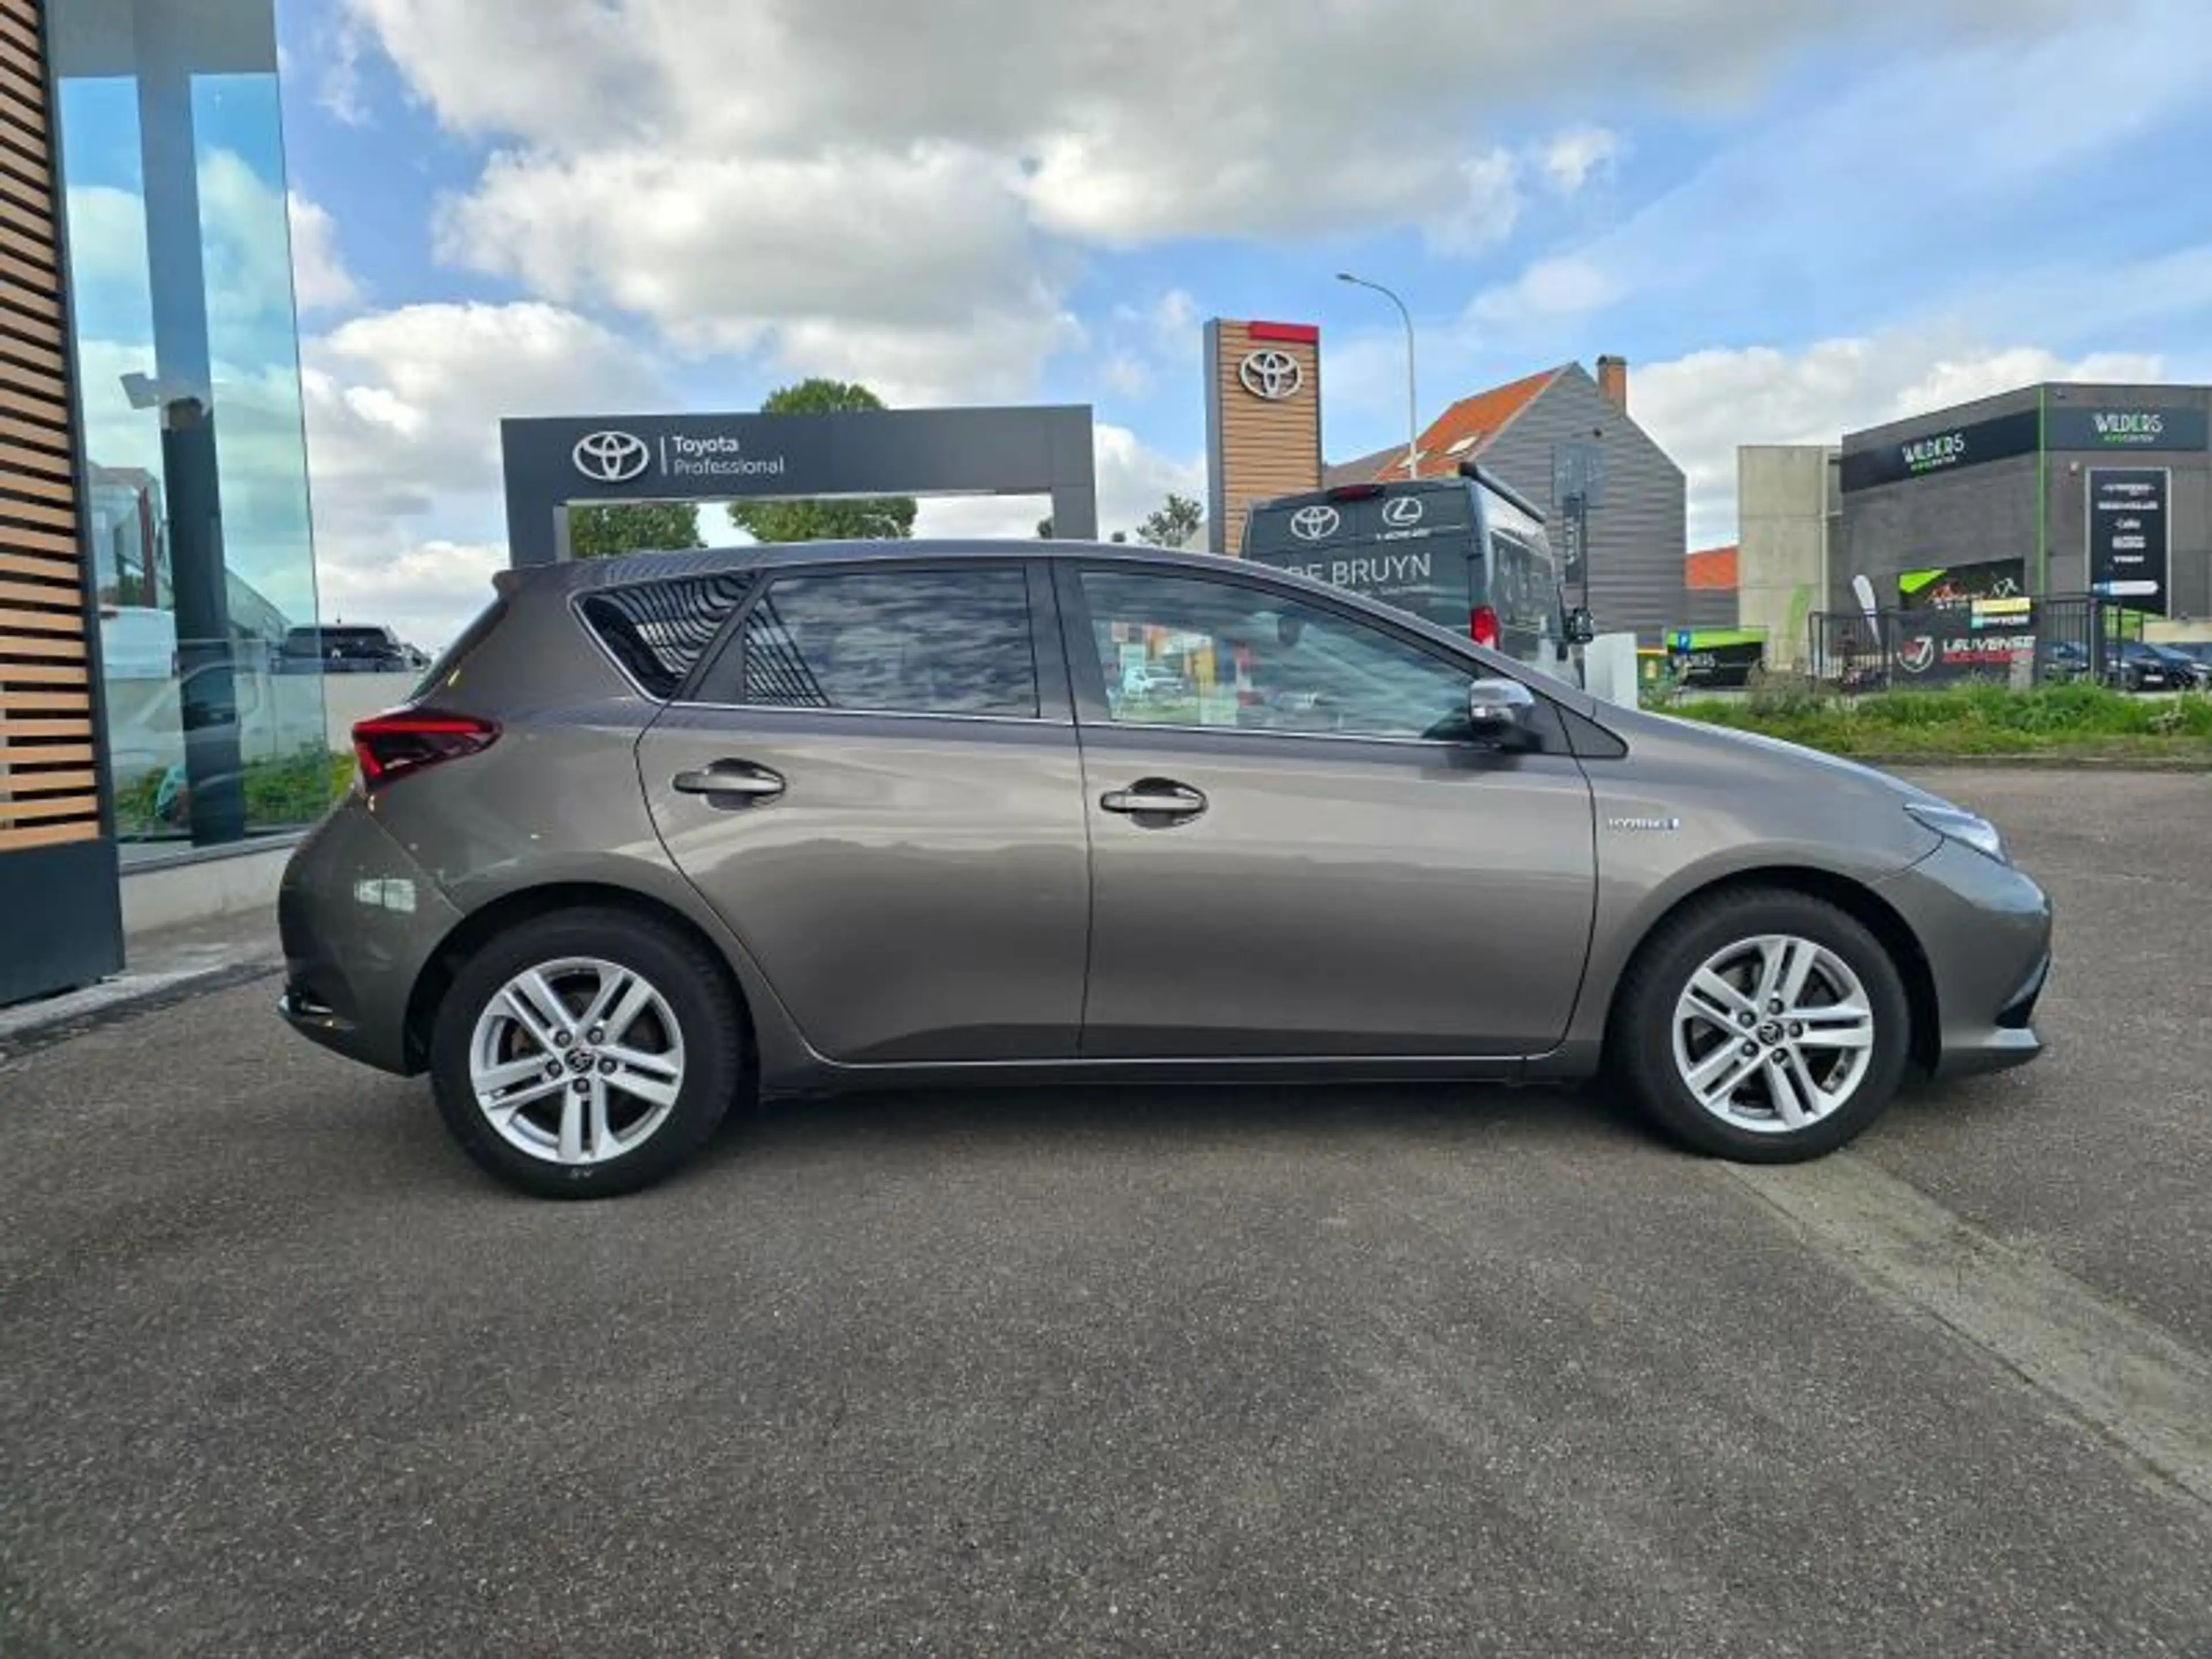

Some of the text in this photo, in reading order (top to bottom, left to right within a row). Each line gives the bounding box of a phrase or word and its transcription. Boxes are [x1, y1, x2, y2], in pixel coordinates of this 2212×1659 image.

[672, 436, 740, 457] Toyota
[673, 456, 785, 476] Professional
[1332, 552, 1431, 585] BRUYN
